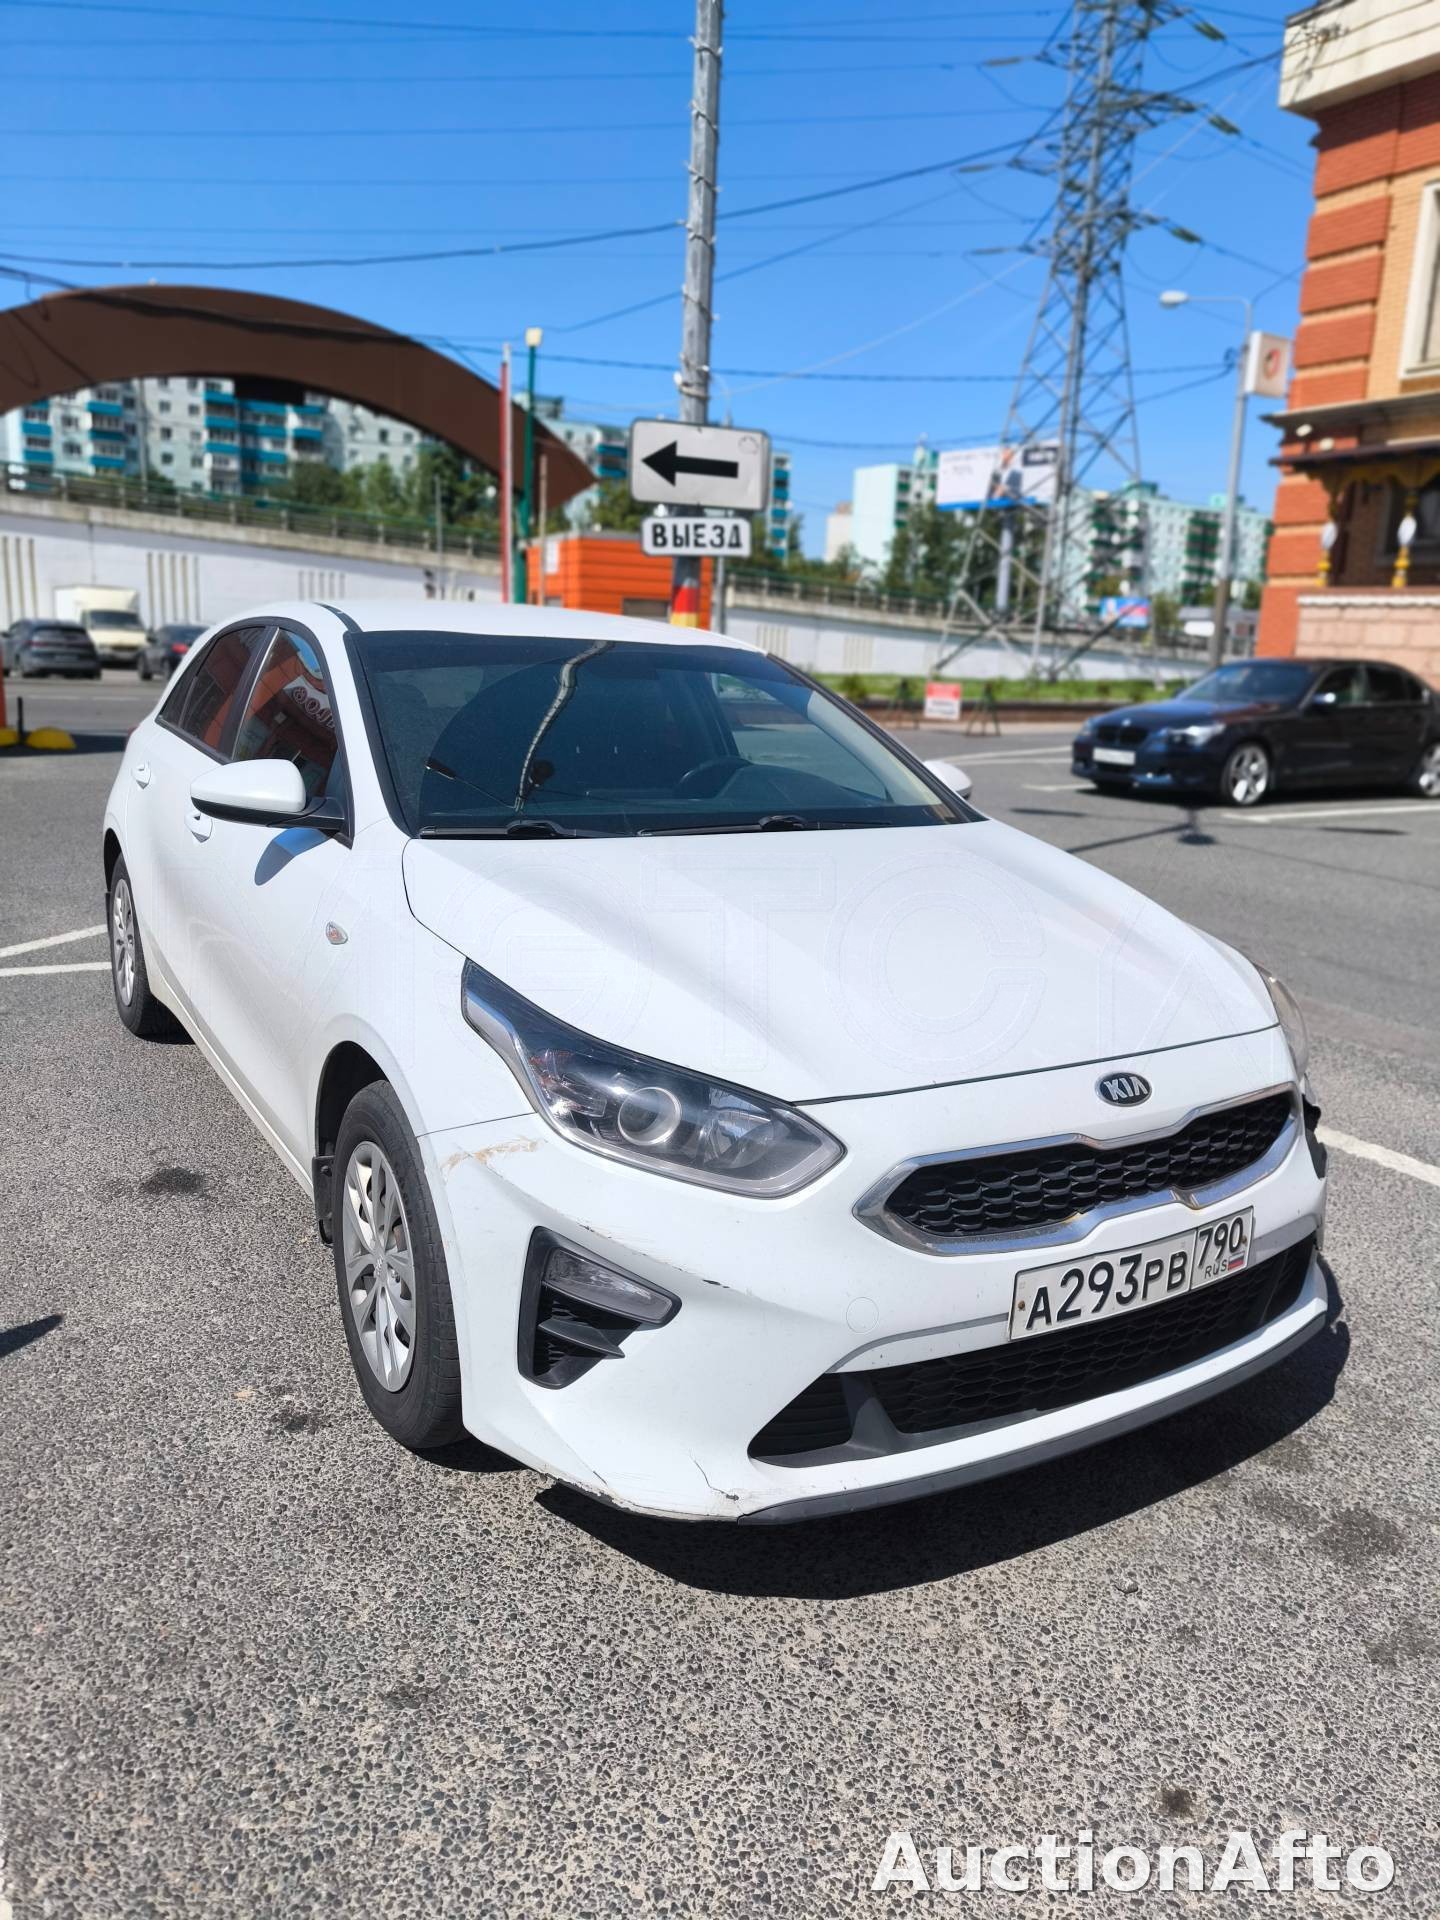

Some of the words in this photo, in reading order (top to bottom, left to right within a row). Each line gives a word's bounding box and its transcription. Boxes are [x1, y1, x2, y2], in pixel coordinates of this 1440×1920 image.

[652, 523, 742, 549] ВЫЕЗД
[1103, 1076, 1148, 1100] KIA
[1198, 1217, 1244, 1269] 790
[1204, 1259, 1228, 1279] RUS
